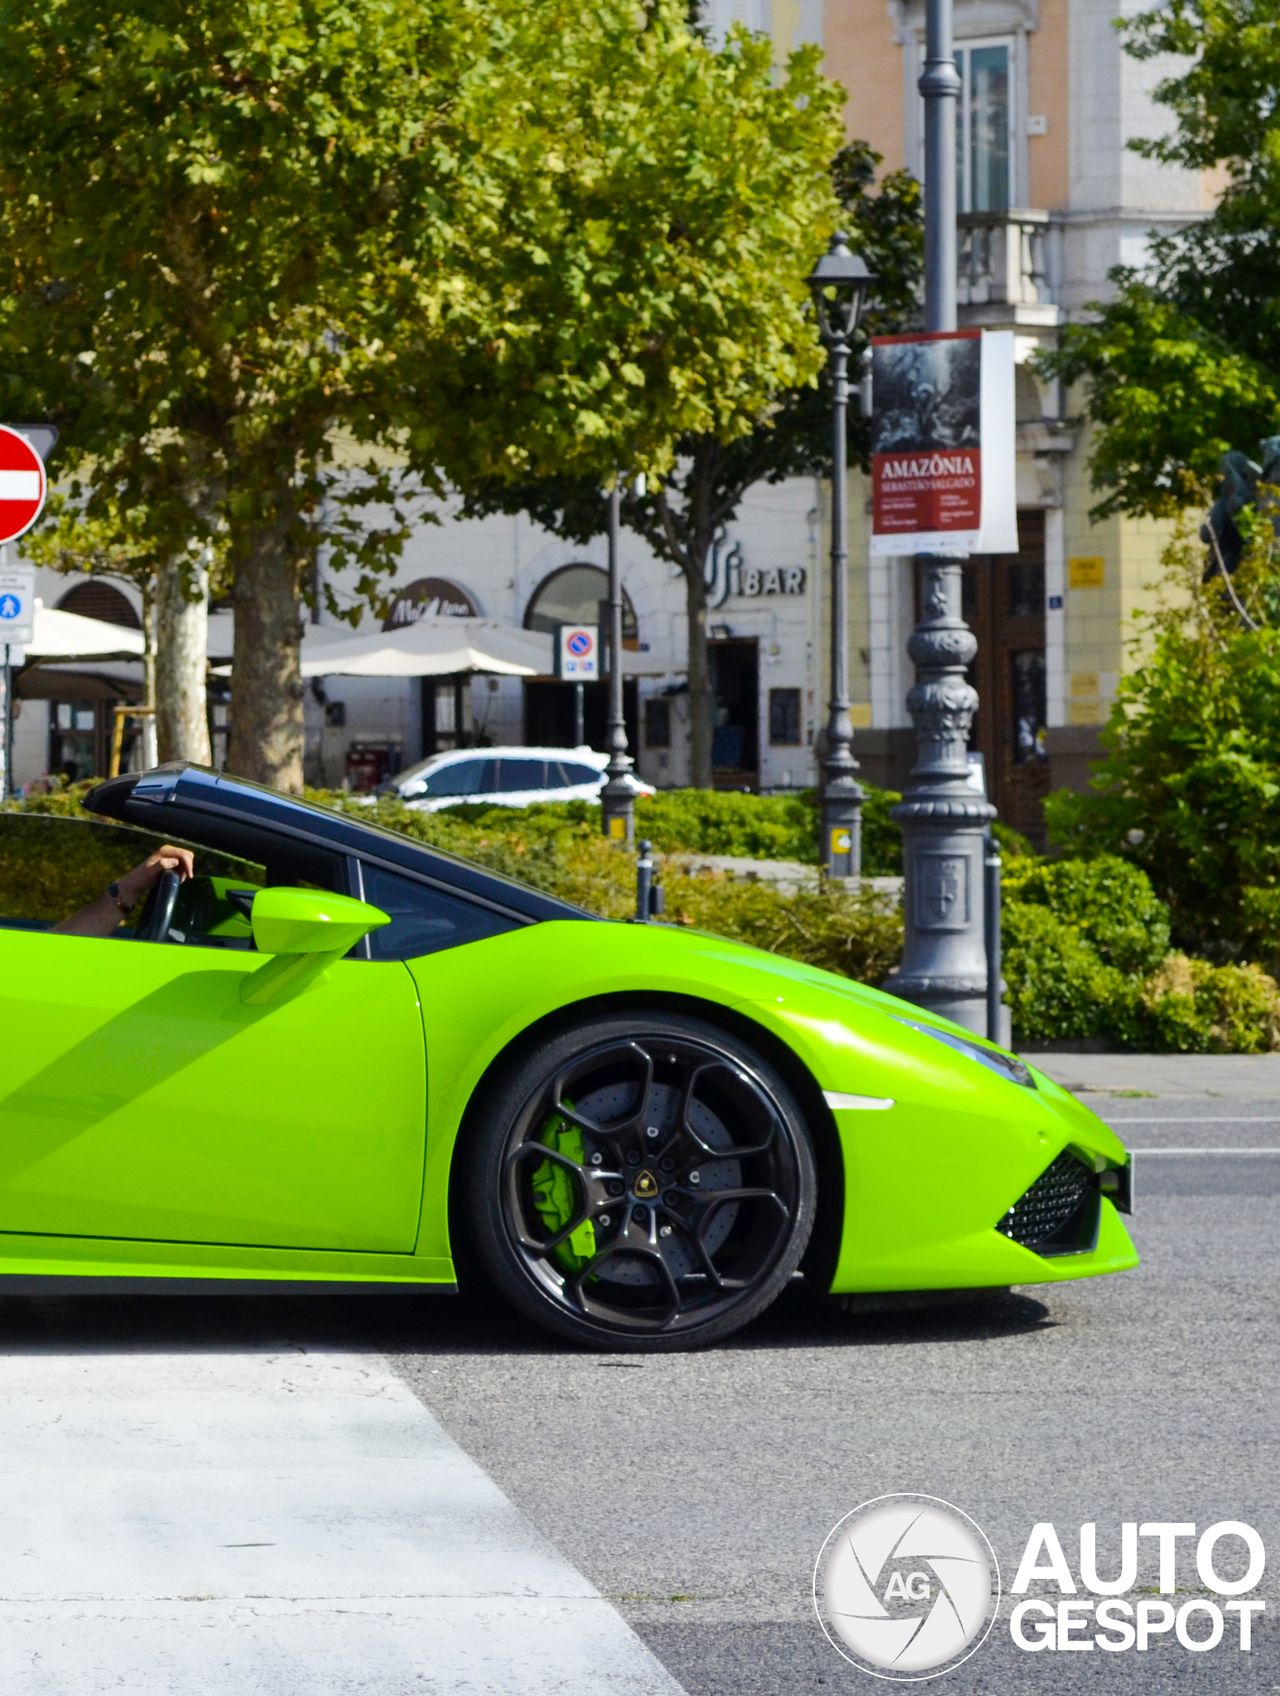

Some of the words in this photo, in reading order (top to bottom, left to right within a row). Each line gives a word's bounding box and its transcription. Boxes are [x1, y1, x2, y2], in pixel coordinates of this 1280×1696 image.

[881, 453, 974, 479] AMAZÔNIA
[931, 476, 976, 490] SALGADO
[744, 567, 804, 596] BAR
